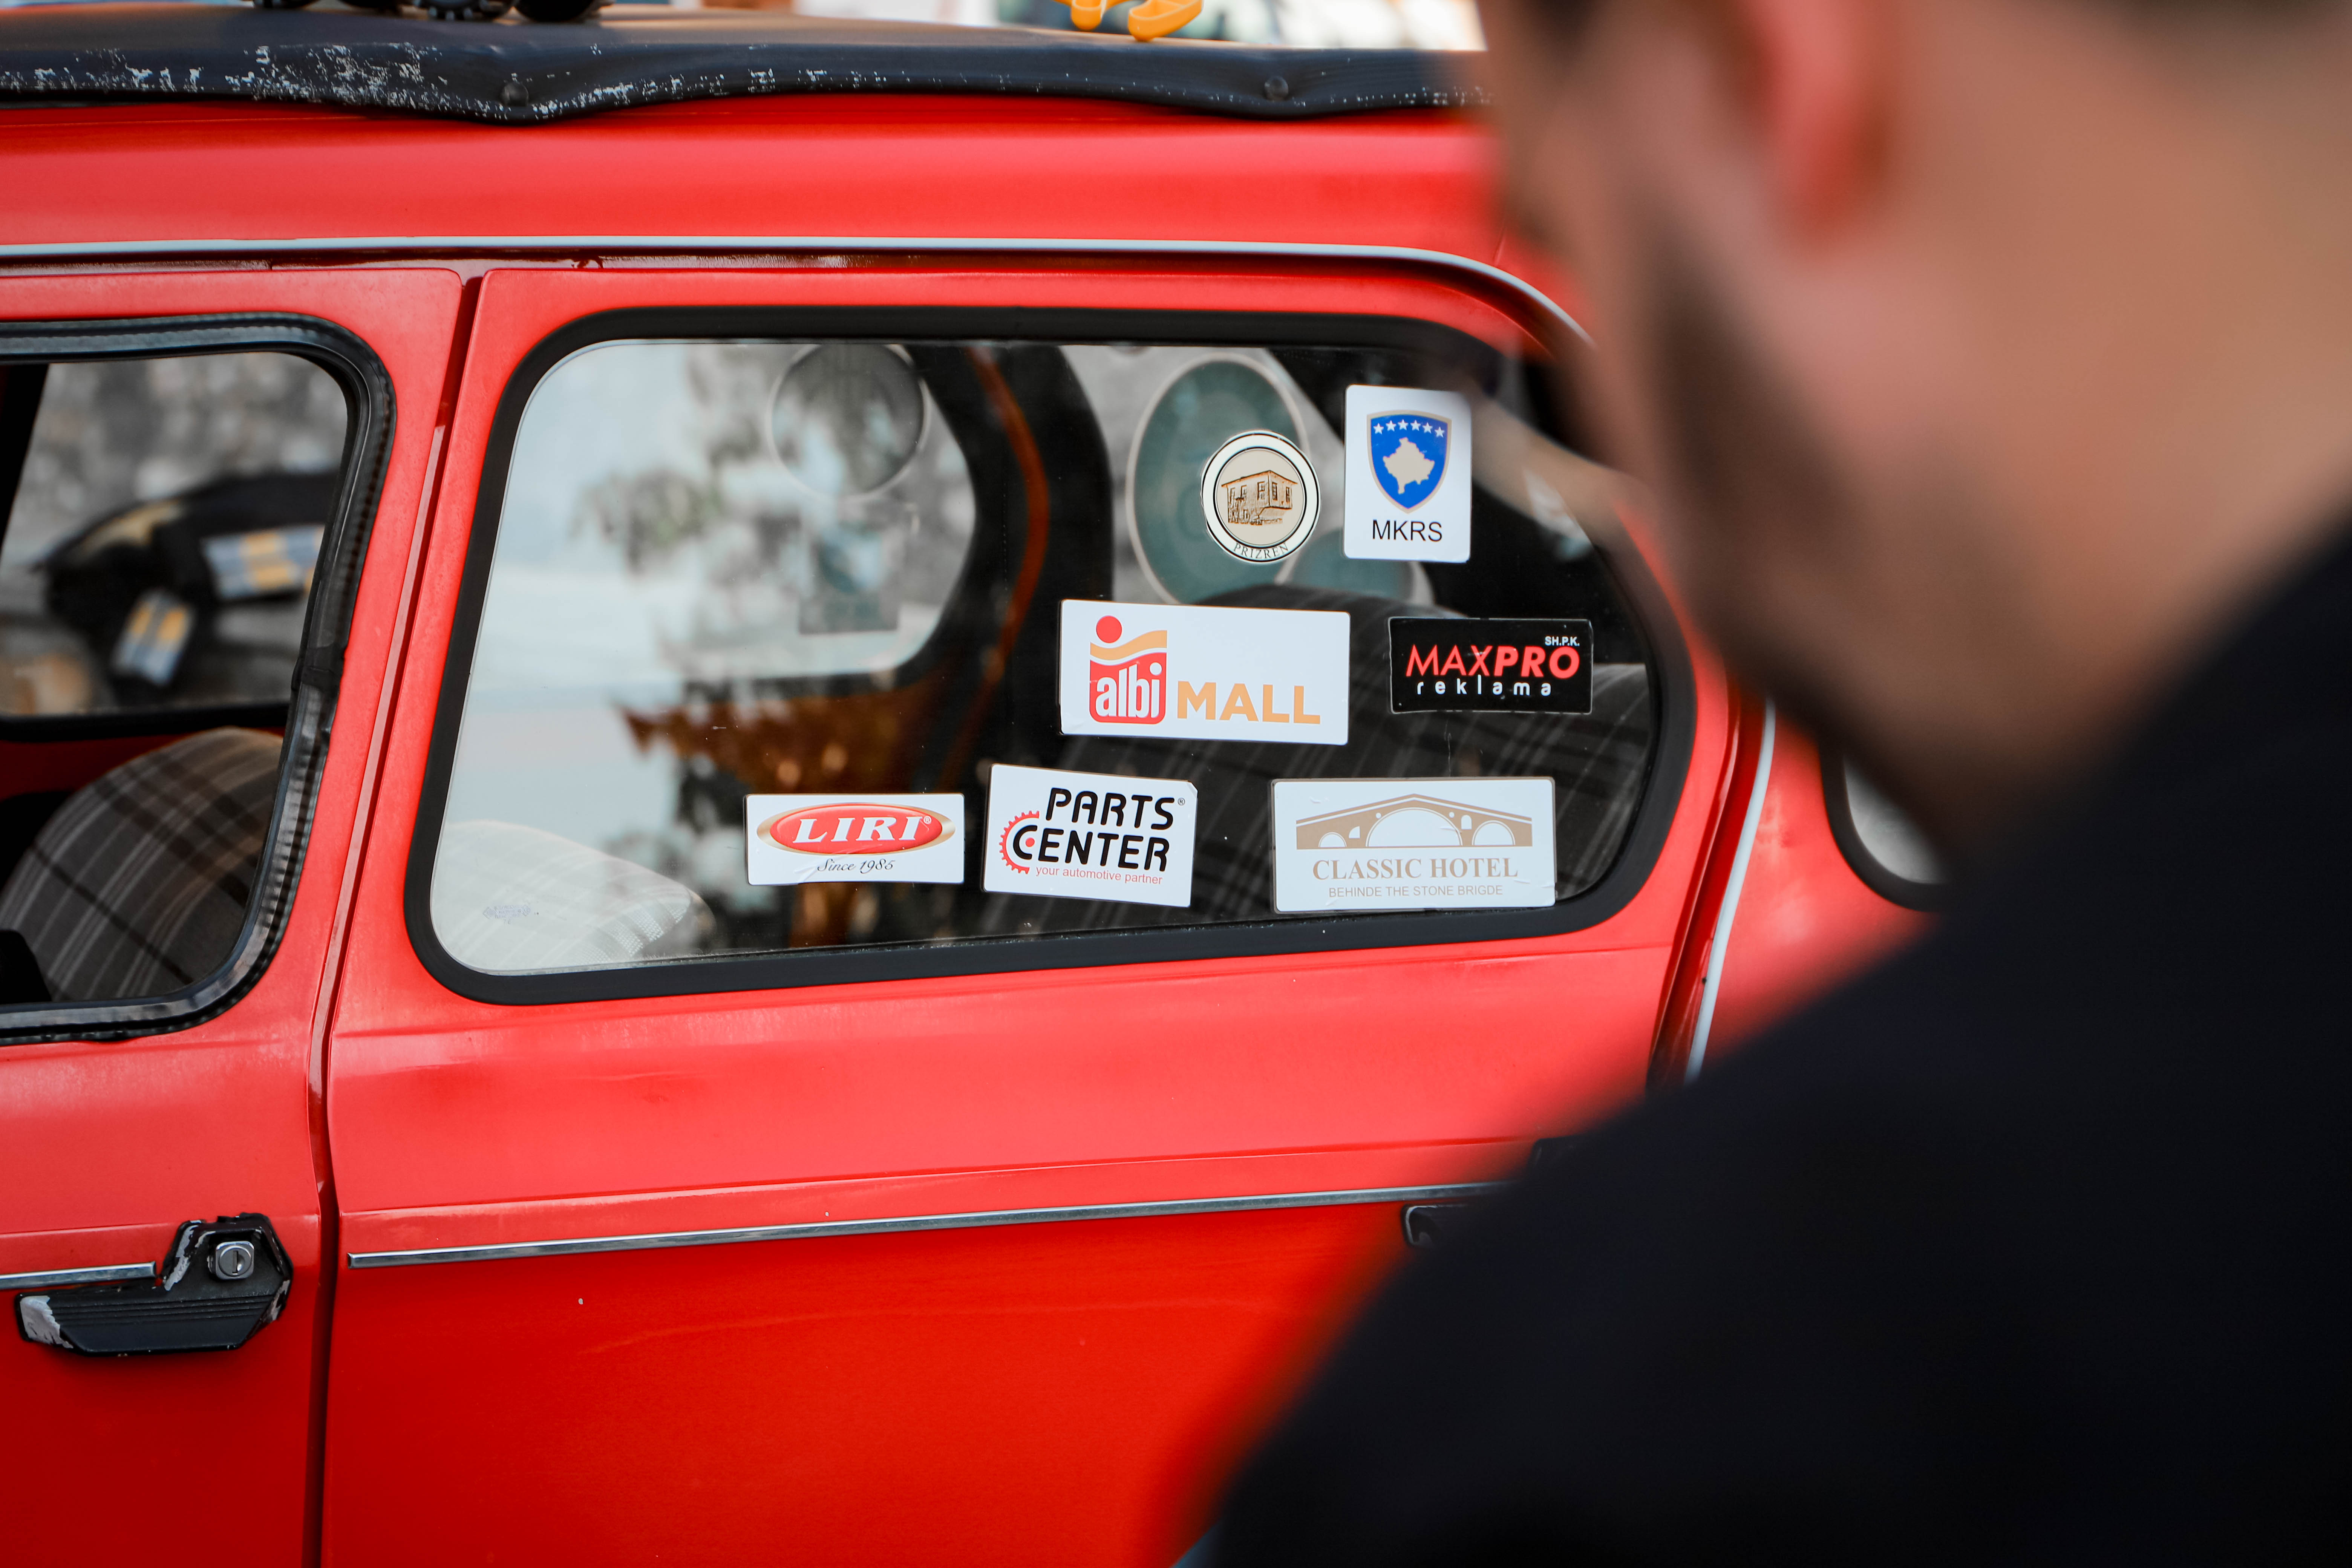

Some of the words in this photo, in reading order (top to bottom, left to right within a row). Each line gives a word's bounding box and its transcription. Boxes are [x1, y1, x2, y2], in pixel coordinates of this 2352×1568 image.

[1372, 519, 1442, 542] MKRS
[1233, 542, 1289, 559] PRIZREN
[1545, 636, 1580, 647] SH.P.K.
[1406, 644, 1580, 679] MAXPRO
[1095, 662, 1163, 718] albi
[1177, 680, 1321, 724] MALL
[1416, 674, 1551, 697] reklama
[1046, 787, 1175, 830] PARTS
[1012, 825, 1170, 872] CENTER
[817, 858, 857, 872] Since
[859, 858, 896, 874] 1985
[1036, 867, 1060, 877] your
[1062, 868, 1122, 881] automotive
[1124, 874, 1163, 885] partner
[1312, 858, 1422, 880] CLASSIC
[1429, 858, 1518, 878] HOTEL
[1329, 887, 1382, 897] BEHINDE
[1386, 886, 1410, 897] THE
[1413, 885, 1454, 896] STONE
[1458, 885, 1503, 896] BRIGDE
